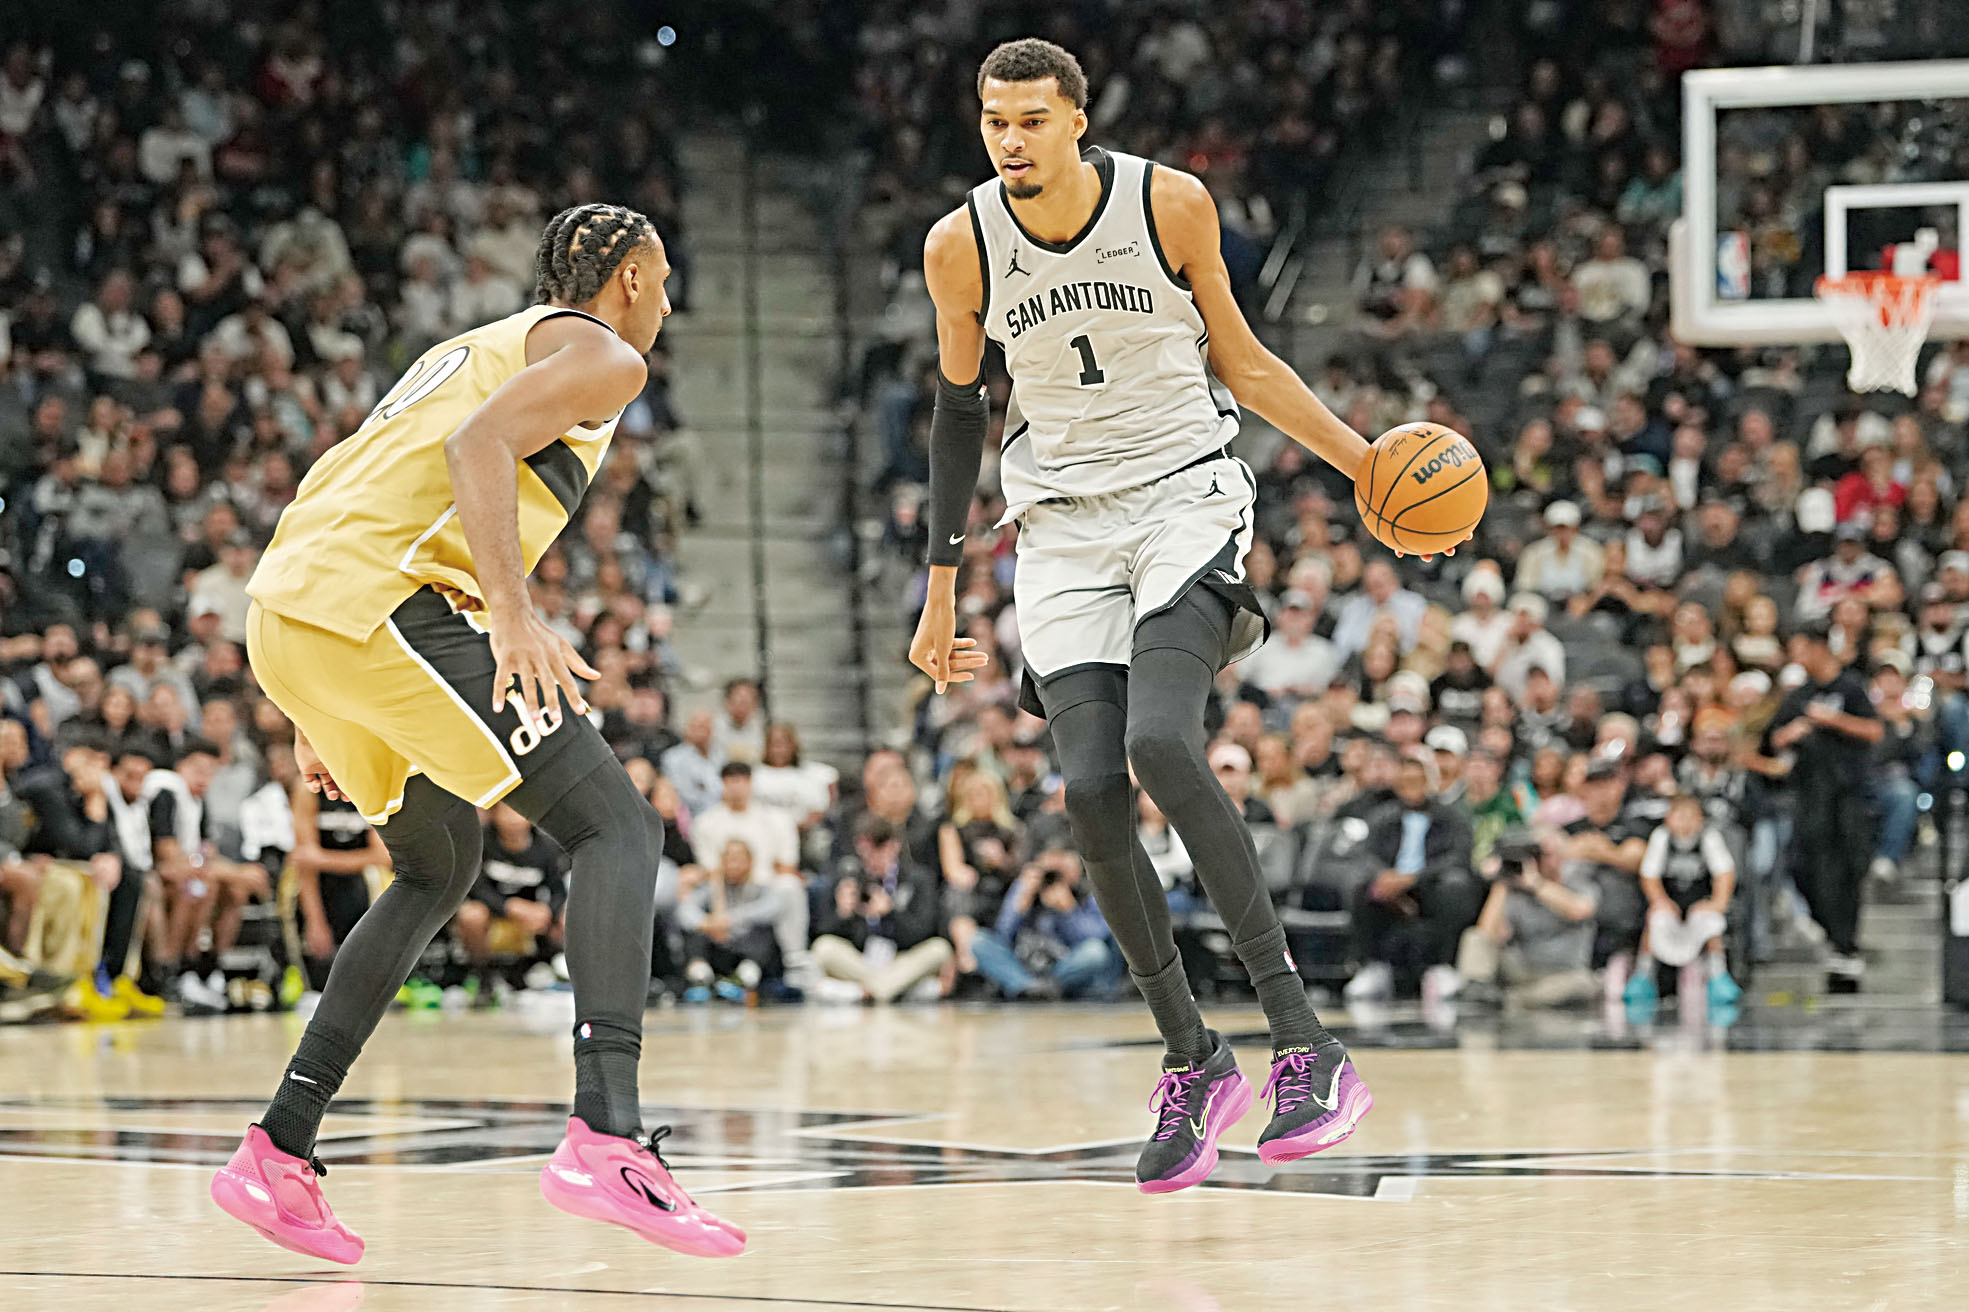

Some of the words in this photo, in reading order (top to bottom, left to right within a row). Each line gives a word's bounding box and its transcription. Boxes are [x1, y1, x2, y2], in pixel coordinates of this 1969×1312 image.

[1101, 246, 1134, 259] LEDGER
[1006, 293, 1047, 339] SAN
[1049, 281, 1154, 317] ANTONIO
[1069, 334, 1105, 387] 1
